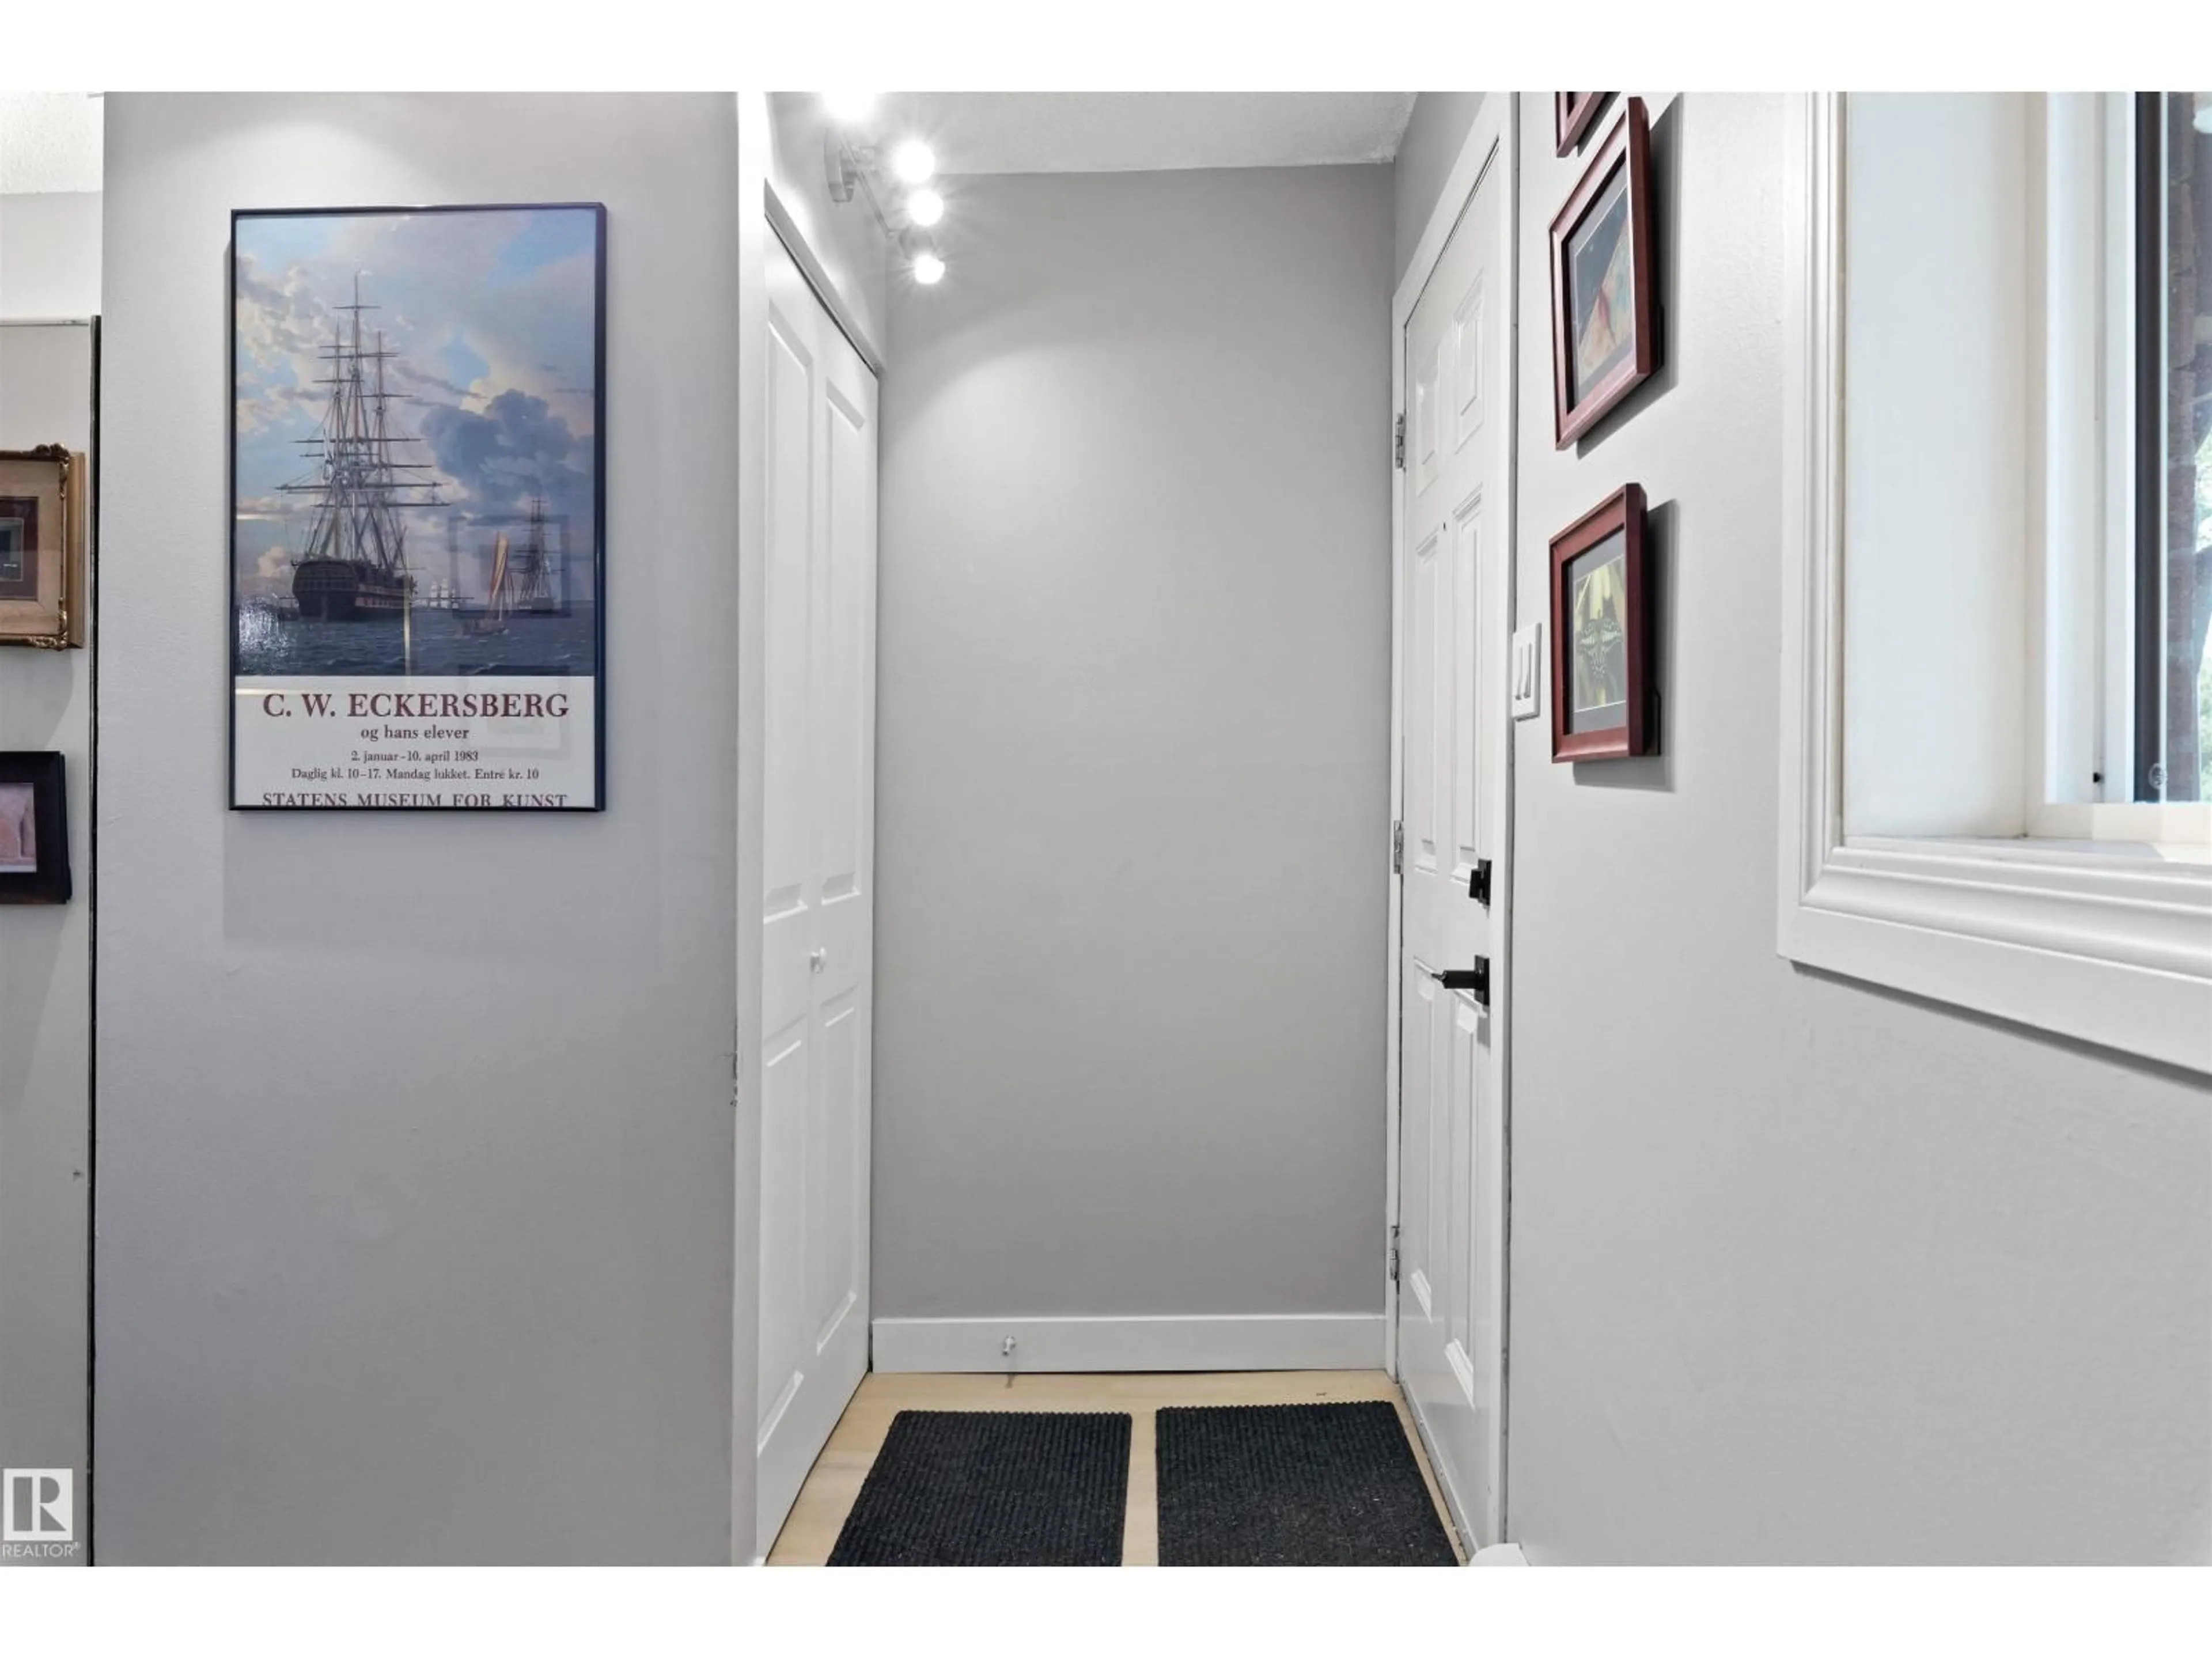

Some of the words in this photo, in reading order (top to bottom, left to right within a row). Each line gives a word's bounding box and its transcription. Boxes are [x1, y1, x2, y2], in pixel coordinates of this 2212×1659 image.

[263, 693, 291, 717] C.
[301, 693, 336, 717] W.
[347, 693, 569, 718] ECKERSBERG
[360, 728, 378, 741] og
[384, 724, 418, 739] hans
[423, 724, 469, 739] elever
[351, 750, 361, 762] 2.
[425, 750, 450, 764] april
[454, 750, 479, 762] 1983
[291, 767, 328, 782] Daglig
[330, 767, 344, 779] kl.
[386, 768, 431, 782] Mandag
[434, 768, 471, 779] lukket.
[508, 768, 523, 779] kr.
[527, 768, 540, 779] 10
[262, 792, 347, 806] STATENS
[357, 793, 442, 806] MUSEUM
[452, 793, 492, 806] FOR
[502, 793, 568, 806] KUNST
